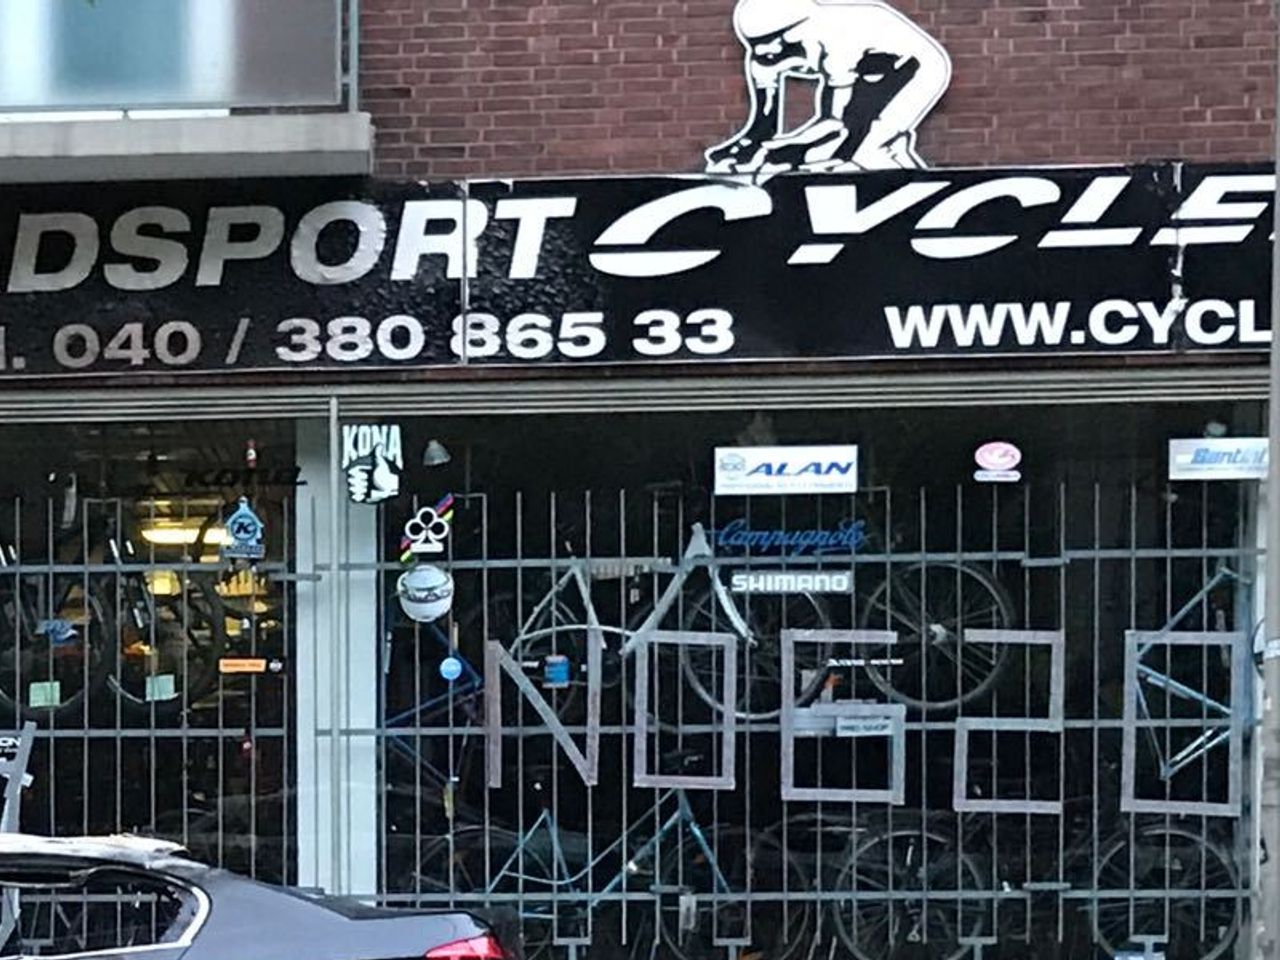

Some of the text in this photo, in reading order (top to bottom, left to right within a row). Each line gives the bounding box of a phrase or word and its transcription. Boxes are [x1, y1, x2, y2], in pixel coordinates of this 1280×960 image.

[587, 174, 1277, 277] CYCLE
[53, 320, 202, 369] 040
[224, 317, 251, 365] /
[274, 314, 426, 363] 380
[449, 311, 608, 360] 865
[631, 308, 736, 357] 33
[341, 424, 404, 470] KONA
[745, 461, 854, 477] ALAN
[731, 574, 849, 592] SHIMANO
